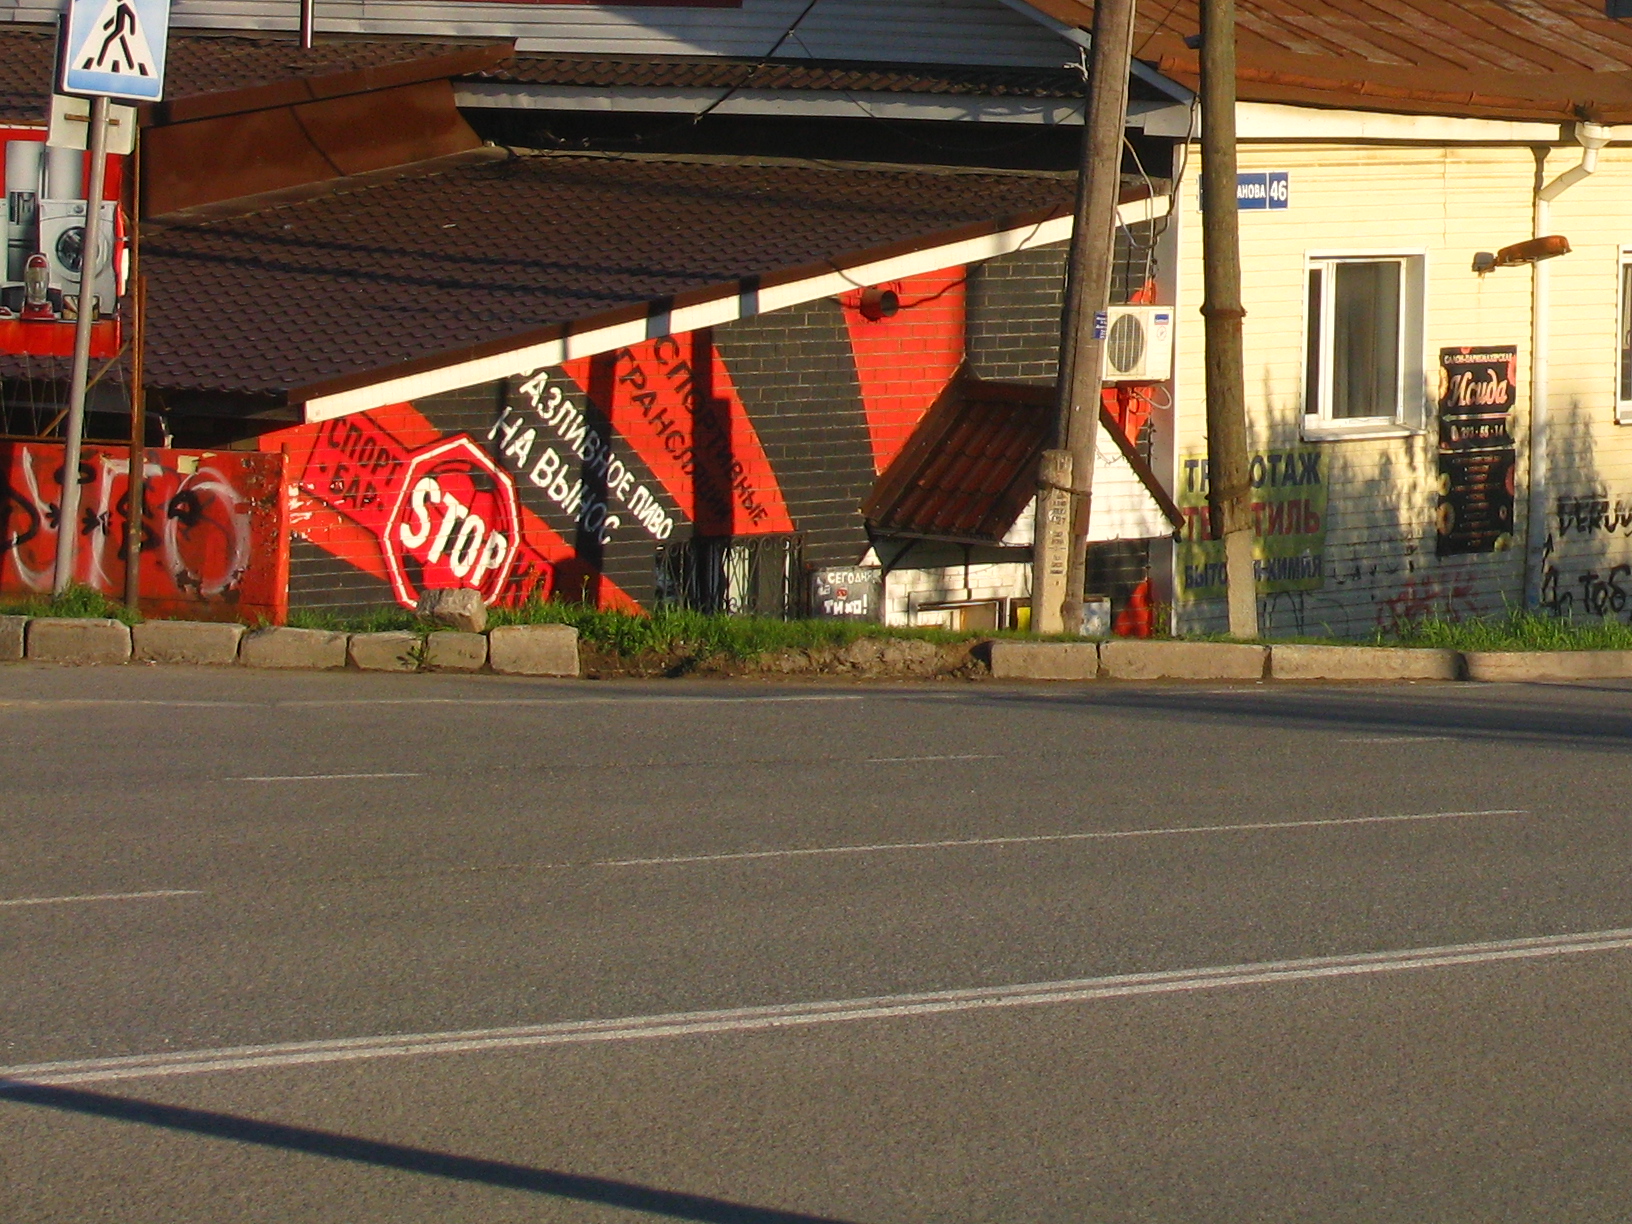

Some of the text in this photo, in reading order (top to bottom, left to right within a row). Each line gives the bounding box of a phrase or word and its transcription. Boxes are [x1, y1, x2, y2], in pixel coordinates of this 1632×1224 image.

[1236, 180, 1287, 201] АНОВА 46
[327, 417, 404, 487] СПОРТ
[487, 406, 621, 545] НА ВЫНОС
[518, 368, 636, 502] АЗЛИВНОЕ
[626, 484, 674, 540] ПИВО
[1184, 451, 1322, 493] ТРОТАЖ
[400, 477, 508, 586] STOP
[1183, 499, 1321, 542] ТЕТИЛЬ
